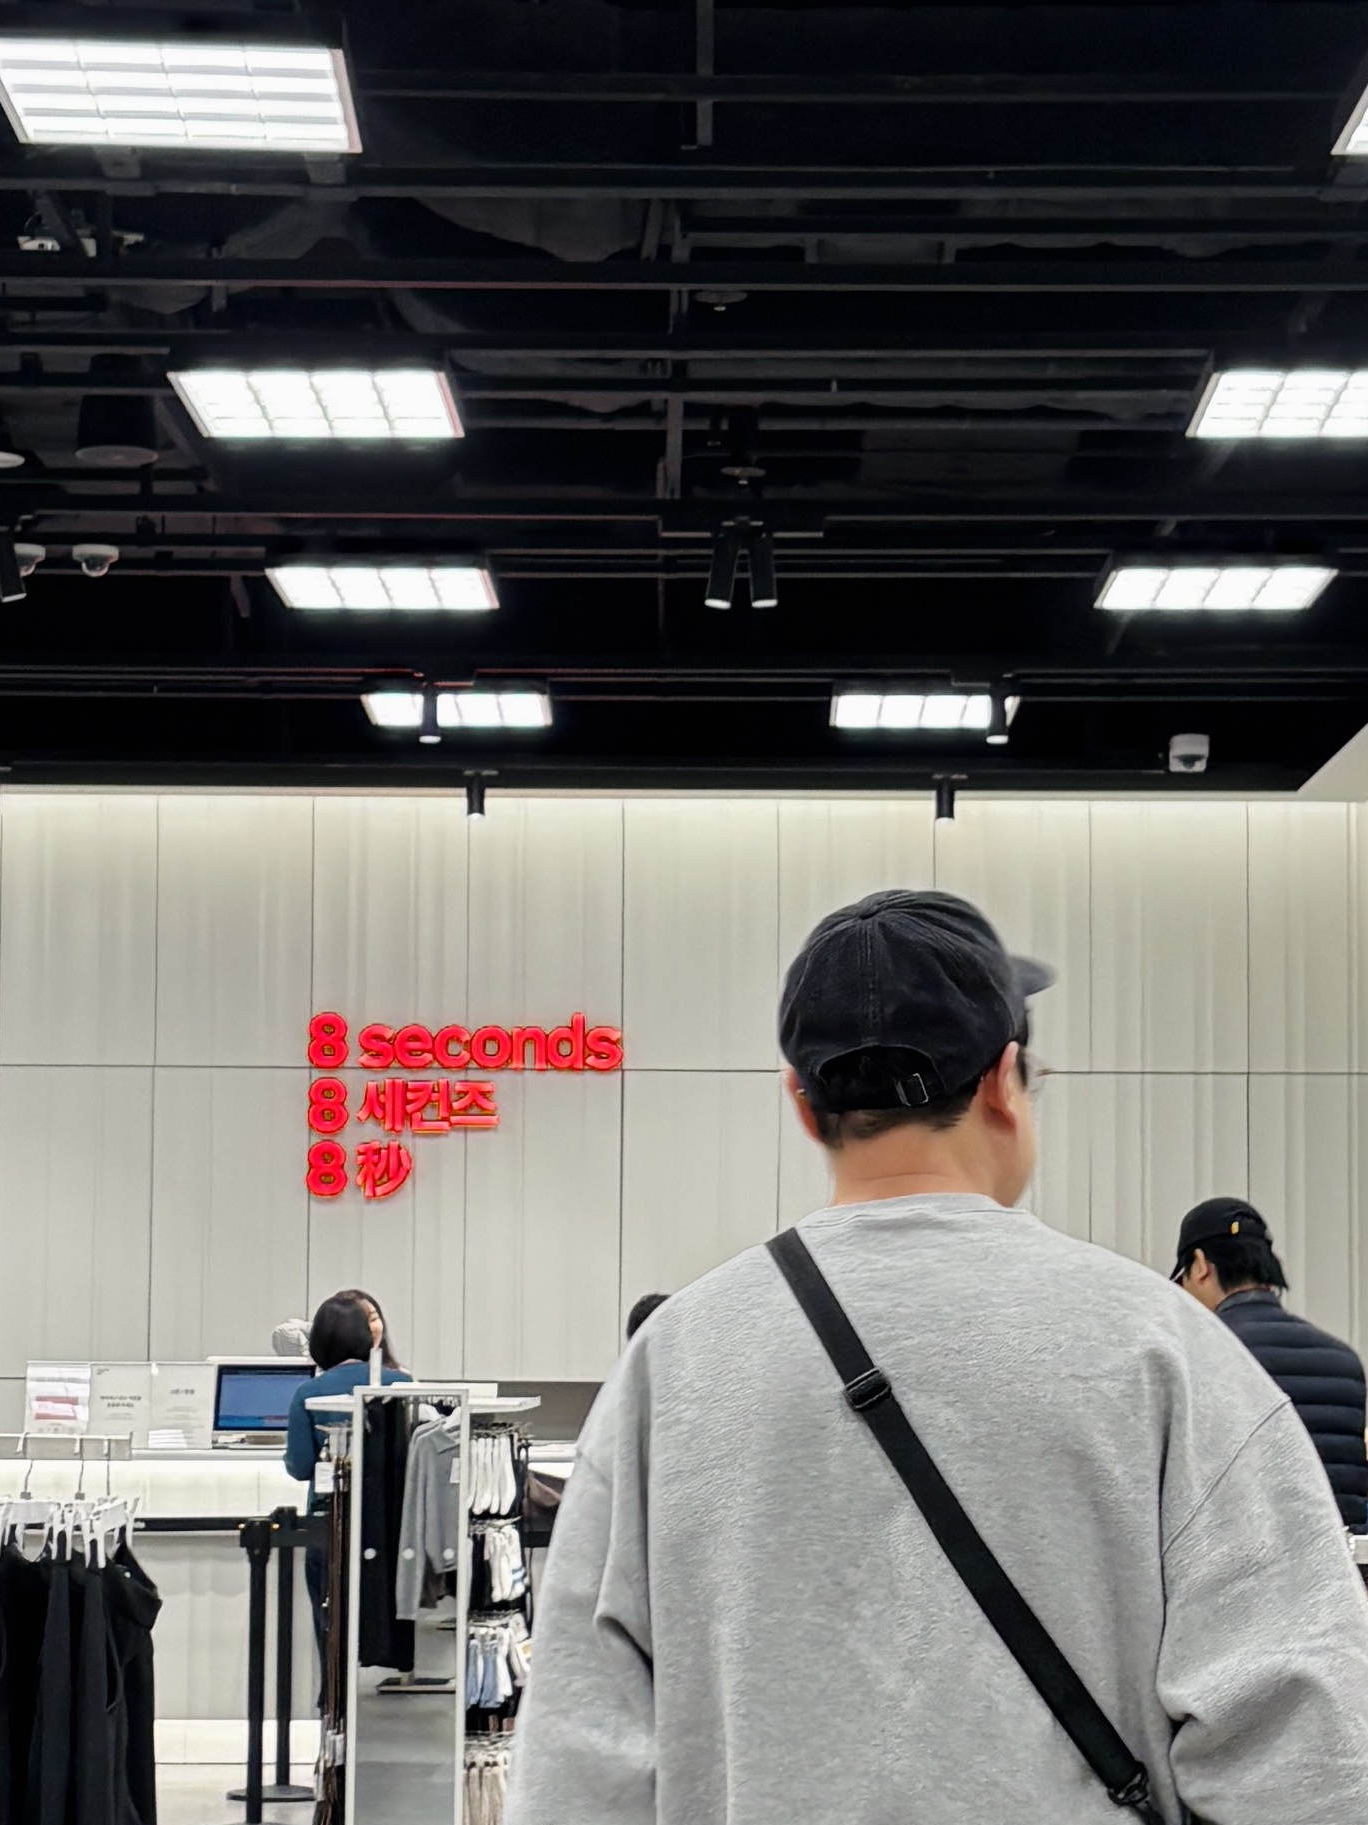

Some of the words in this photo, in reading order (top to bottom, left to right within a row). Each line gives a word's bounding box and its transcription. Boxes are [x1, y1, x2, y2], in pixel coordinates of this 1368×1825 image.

[308, 1011, 348, 1069] 8
[357, 1011, 624, 1071] seconds
[308, 1077, 348, 1134] 8
[356, 1078, 499, 1133] 세컨즈
[306, 1139, 348, 1197] 8
[355, 1140, 412, 1200] 秒
